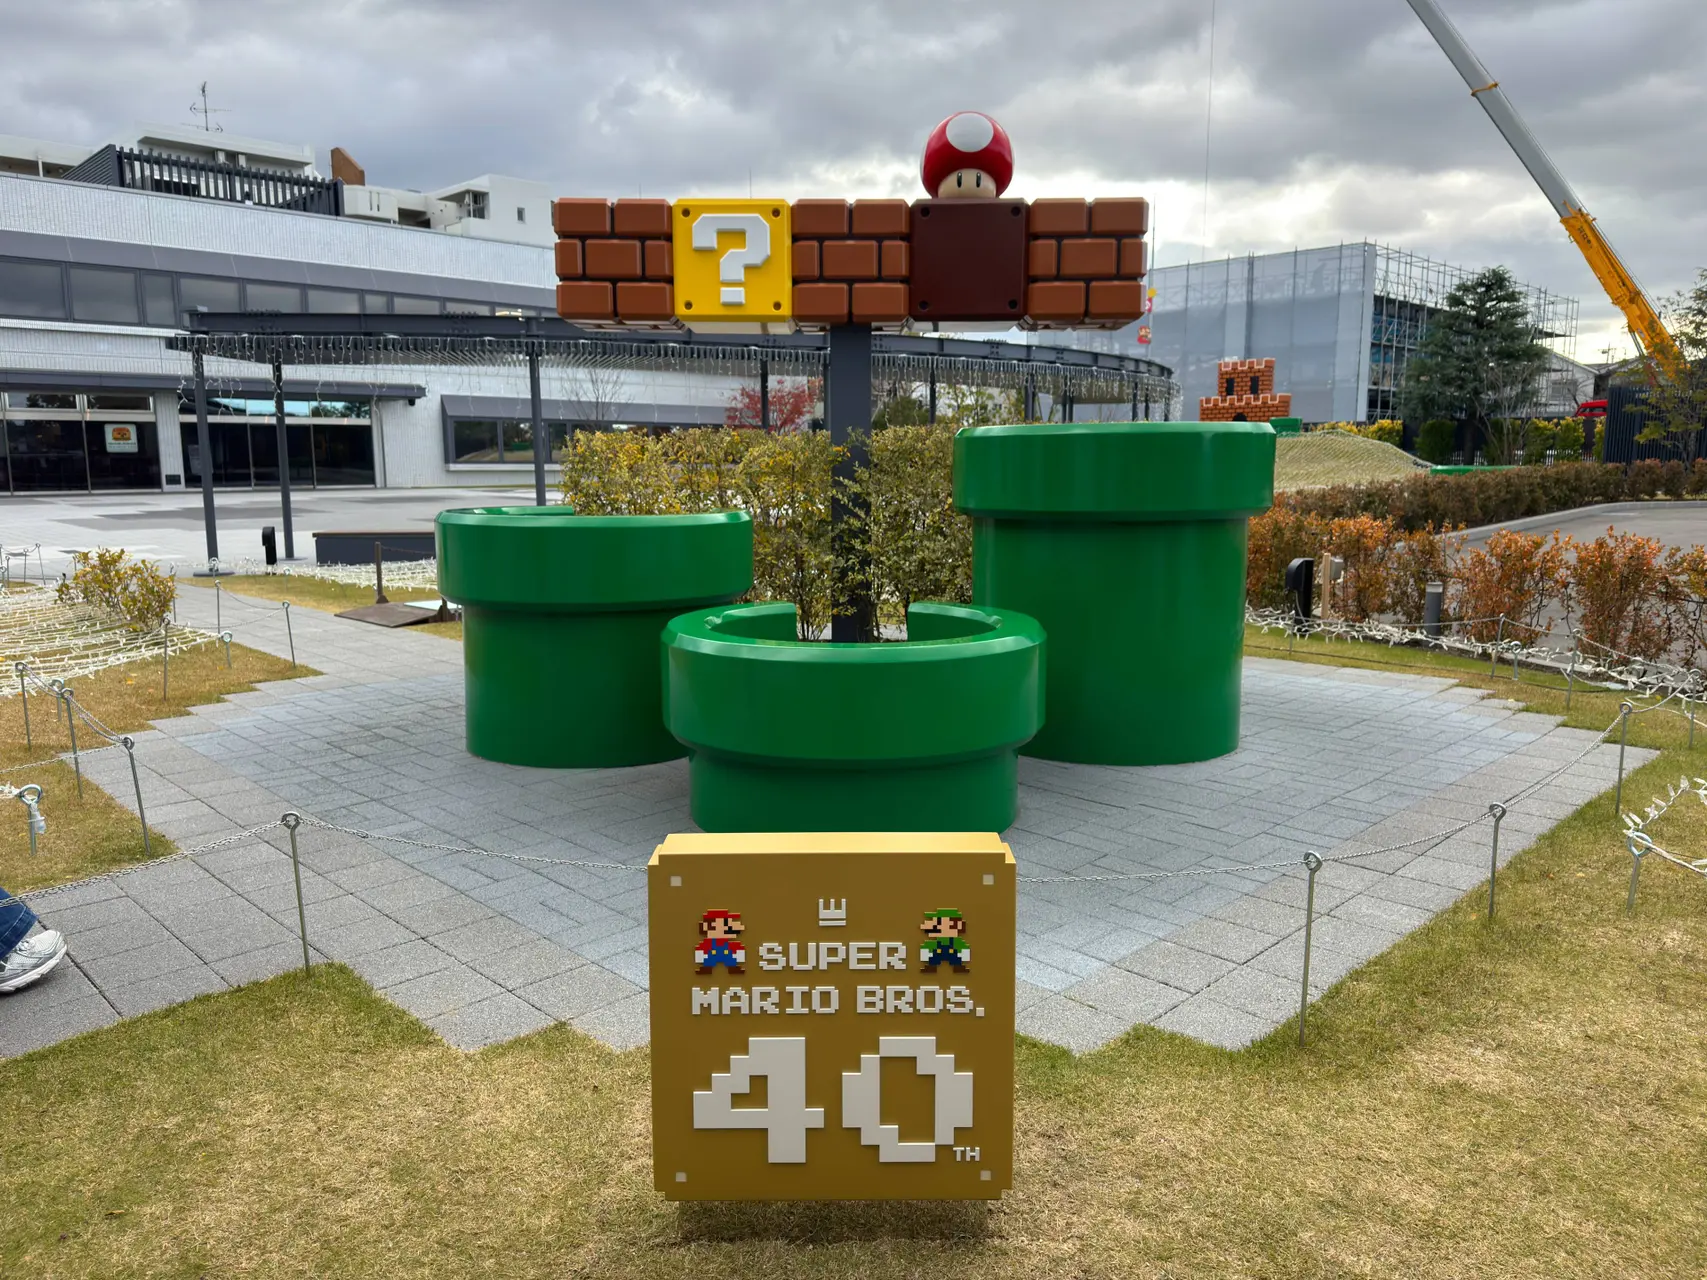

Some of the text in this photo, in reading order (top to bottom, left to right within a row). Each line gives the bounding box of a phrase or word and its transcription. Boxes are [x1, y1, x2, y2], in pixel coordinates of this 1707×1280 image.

[692, 213, 771, 306] ?
[759, 942, 907, 971] SUPER
[692, 985, 985, 1017] MARIO BROS.
[693, 1036, 980, 1163] 40 TH
